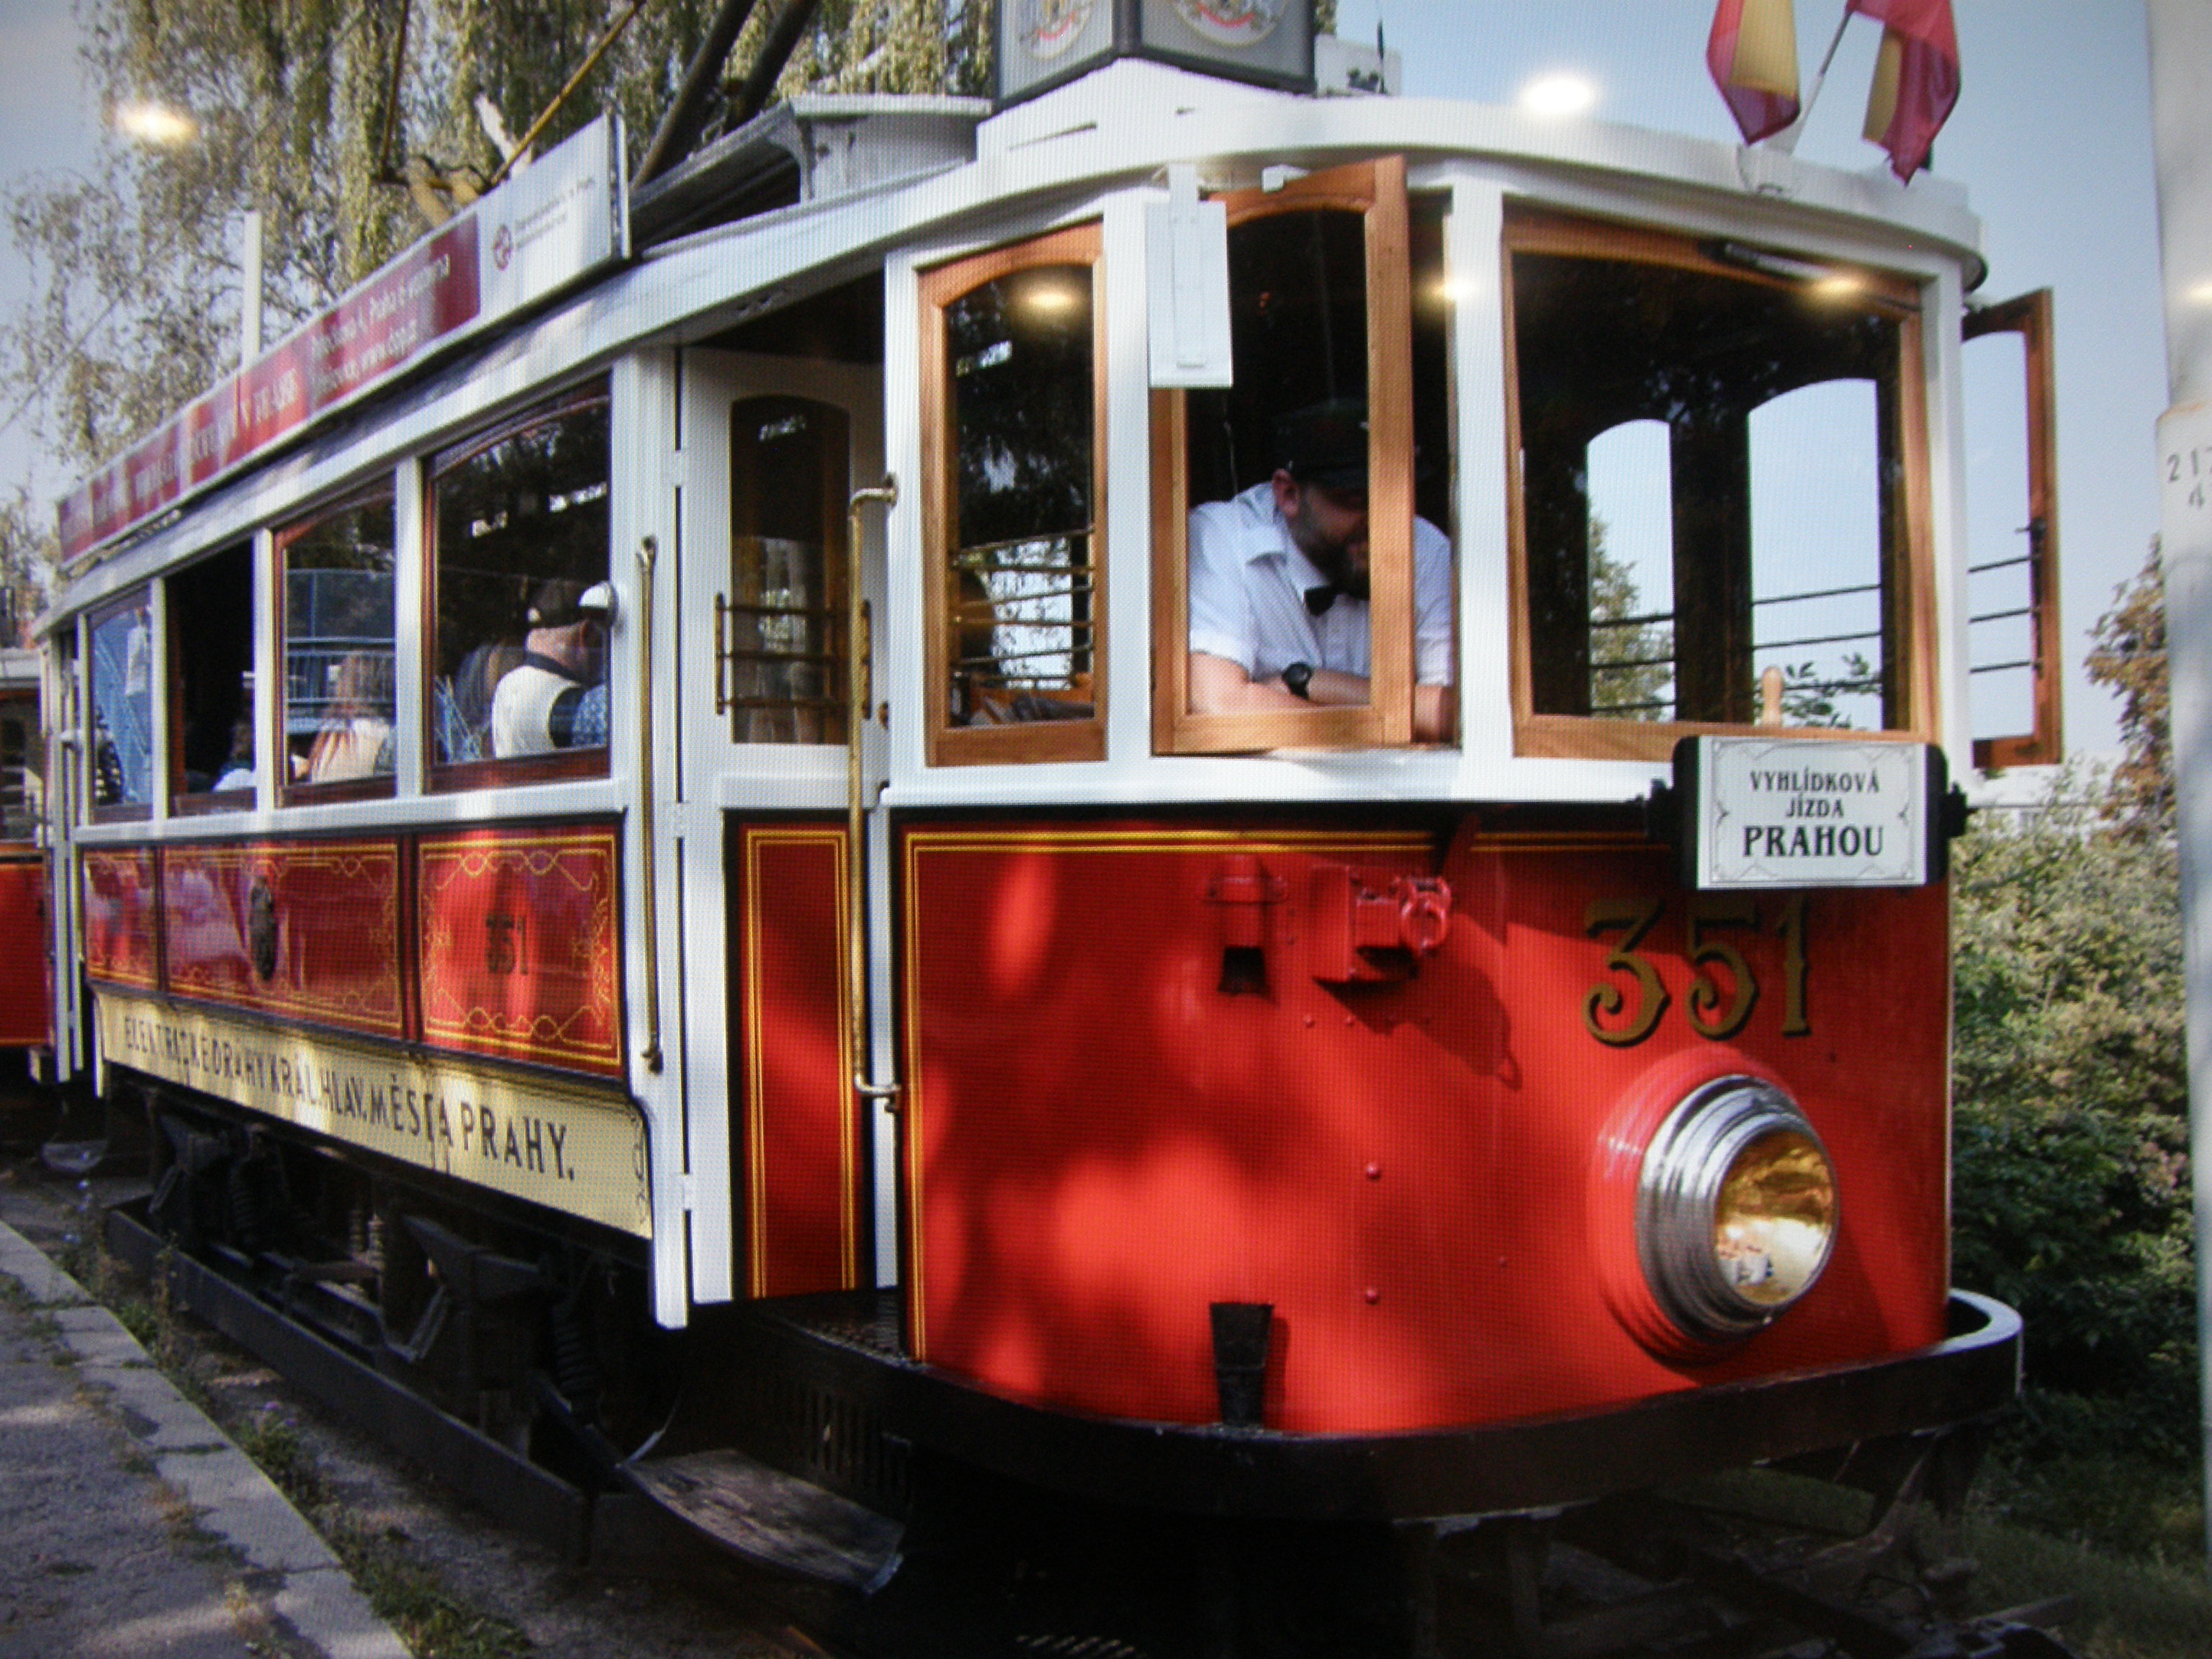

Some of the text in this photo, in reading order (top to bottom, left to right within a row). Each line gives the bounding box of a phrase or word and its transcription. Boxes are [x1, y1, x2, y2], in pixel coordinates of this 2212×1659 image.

[1749, 765, 1880, 793] VYHLÍDKOVÁ
[1785, 794, 1844, 819] JÍZDA
[1742, 824, 1883, 858] PRAHOU
[1581, 893, 1812, 1049] 351
[370, 1072, 454, 1148] MĚSTA
[459, 1100, 575, 1181] PRAHY.
